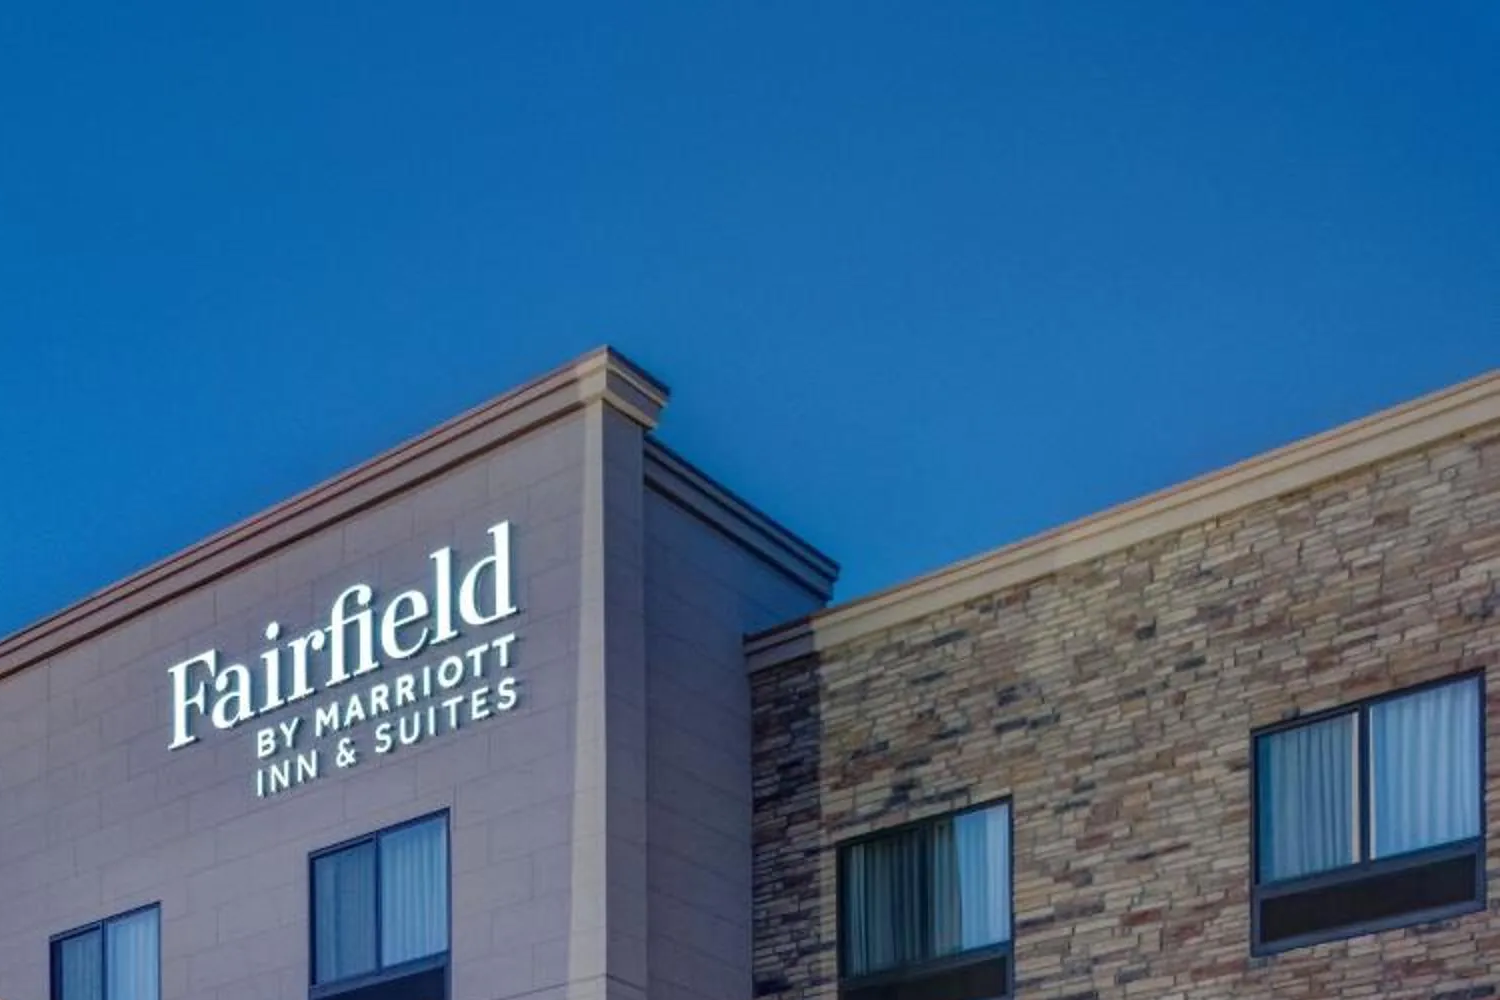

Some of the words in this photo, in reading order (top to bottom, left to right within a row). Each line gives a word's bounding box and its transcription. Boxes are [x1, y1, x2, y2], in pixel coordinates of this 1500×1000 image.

[168, 520, 517, 750] Fairfield
[257, 717, 299, 759] BY
[315, 632, 515, 737] MARRIOTT
[257, 749, 317, 797] INN
[336, 737, 357, 768] &
[375, 677, 517, 753] SUITES
